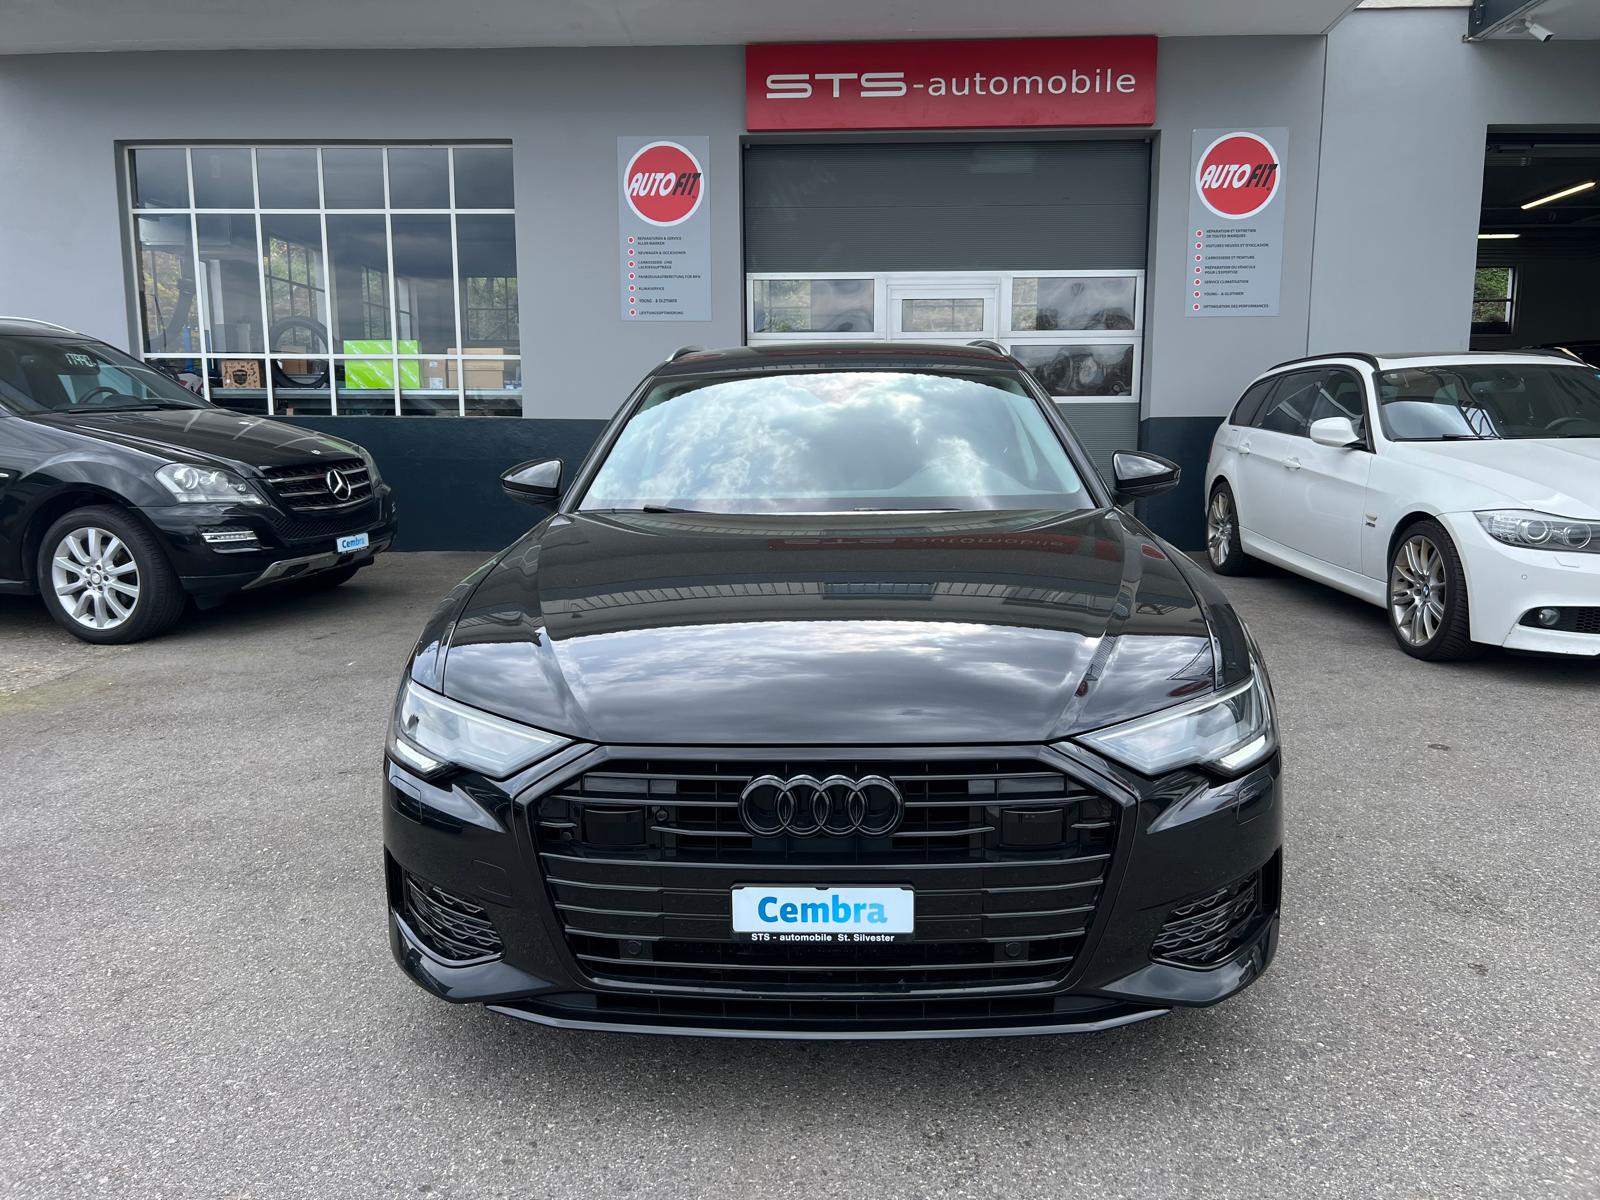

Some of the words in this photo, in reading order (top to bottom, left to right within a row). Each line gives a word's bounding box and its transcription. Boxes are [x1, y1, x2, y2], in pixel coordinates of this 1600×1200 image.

[766, 68, 1136, 99] STS-automobile
[758, 895, 888, 924] Cembra
[751, 934, 770, 942] STS
[779, 934, 832, 942] automobile
[853, 934, 895, 942] Silvester
